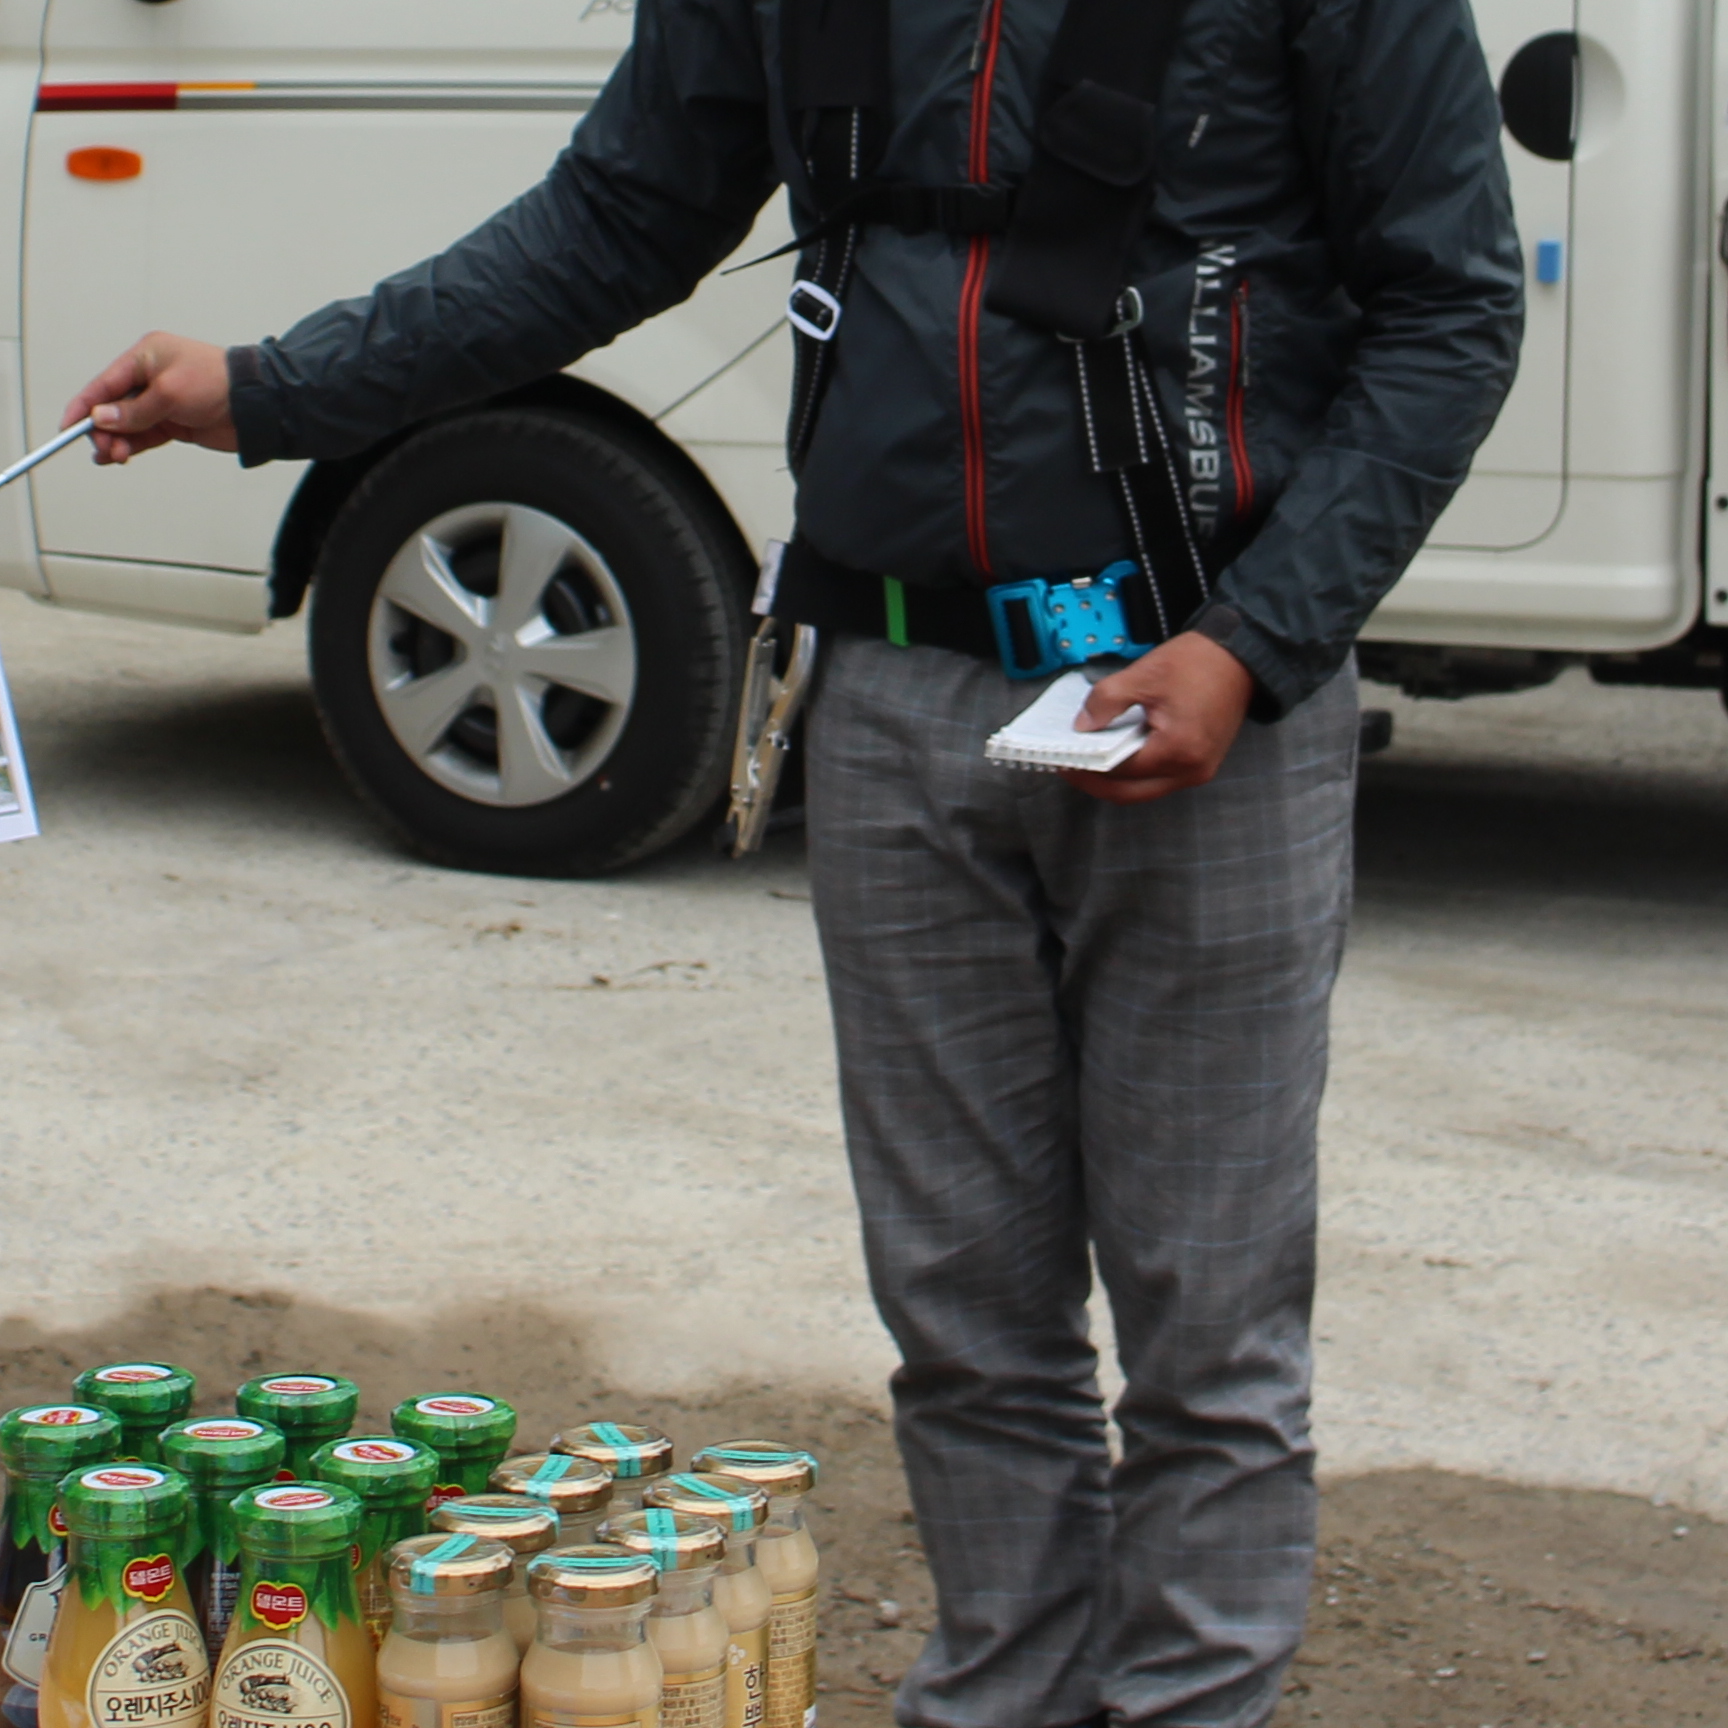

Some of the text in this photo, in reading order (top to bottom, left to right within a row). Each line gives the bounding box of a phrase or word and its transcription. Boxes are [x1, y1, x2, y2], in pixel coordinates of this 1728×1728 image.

[129, 1564, 172, 1587] 델몬트
[256, 1592, 304, 1613] 델몬트
[104, 1622, 172, 1678] ORANGE
[221, 1652, 335, 1705] ORANGE JUICE
